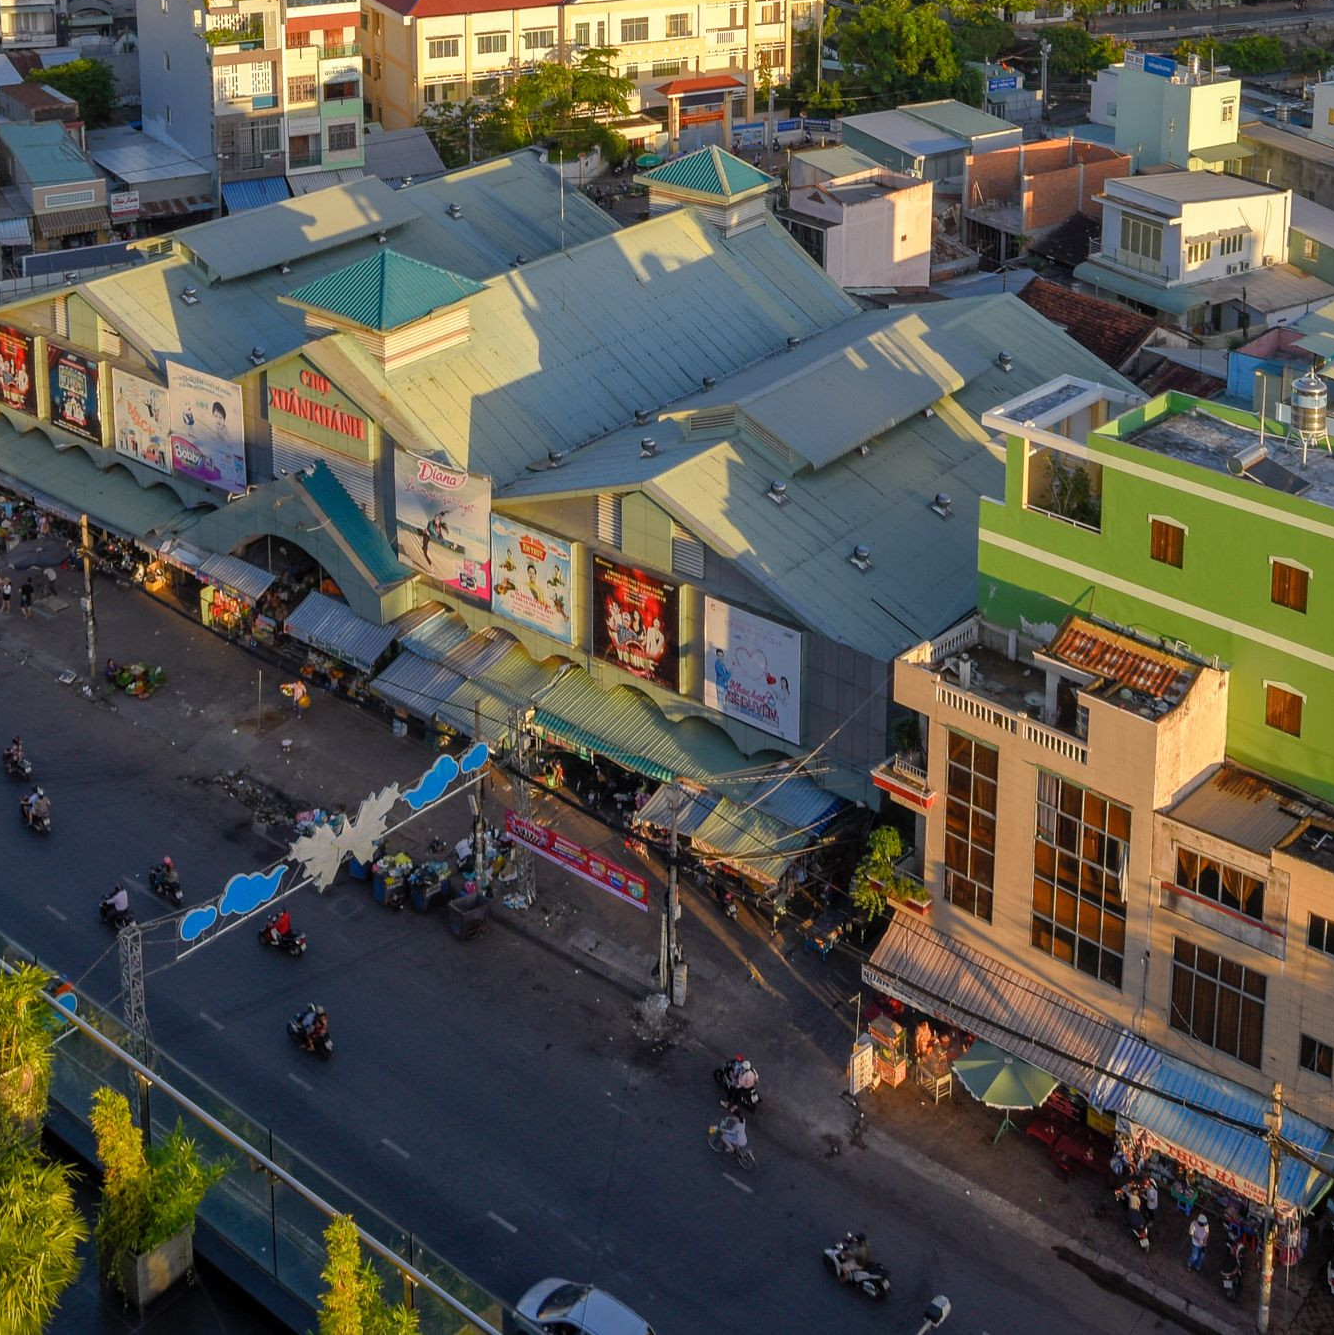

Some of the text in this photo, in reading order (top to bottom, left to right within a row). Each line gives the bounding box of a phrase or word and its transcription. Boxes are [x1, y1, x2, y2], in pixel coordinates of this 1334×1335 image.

[300, 369, 332, 397] CHỢ
[268, 386, 313, 422] XUÂN
[313, 403, 365, 441] KHÁNH
[419, 462, 458, 486] Diana
